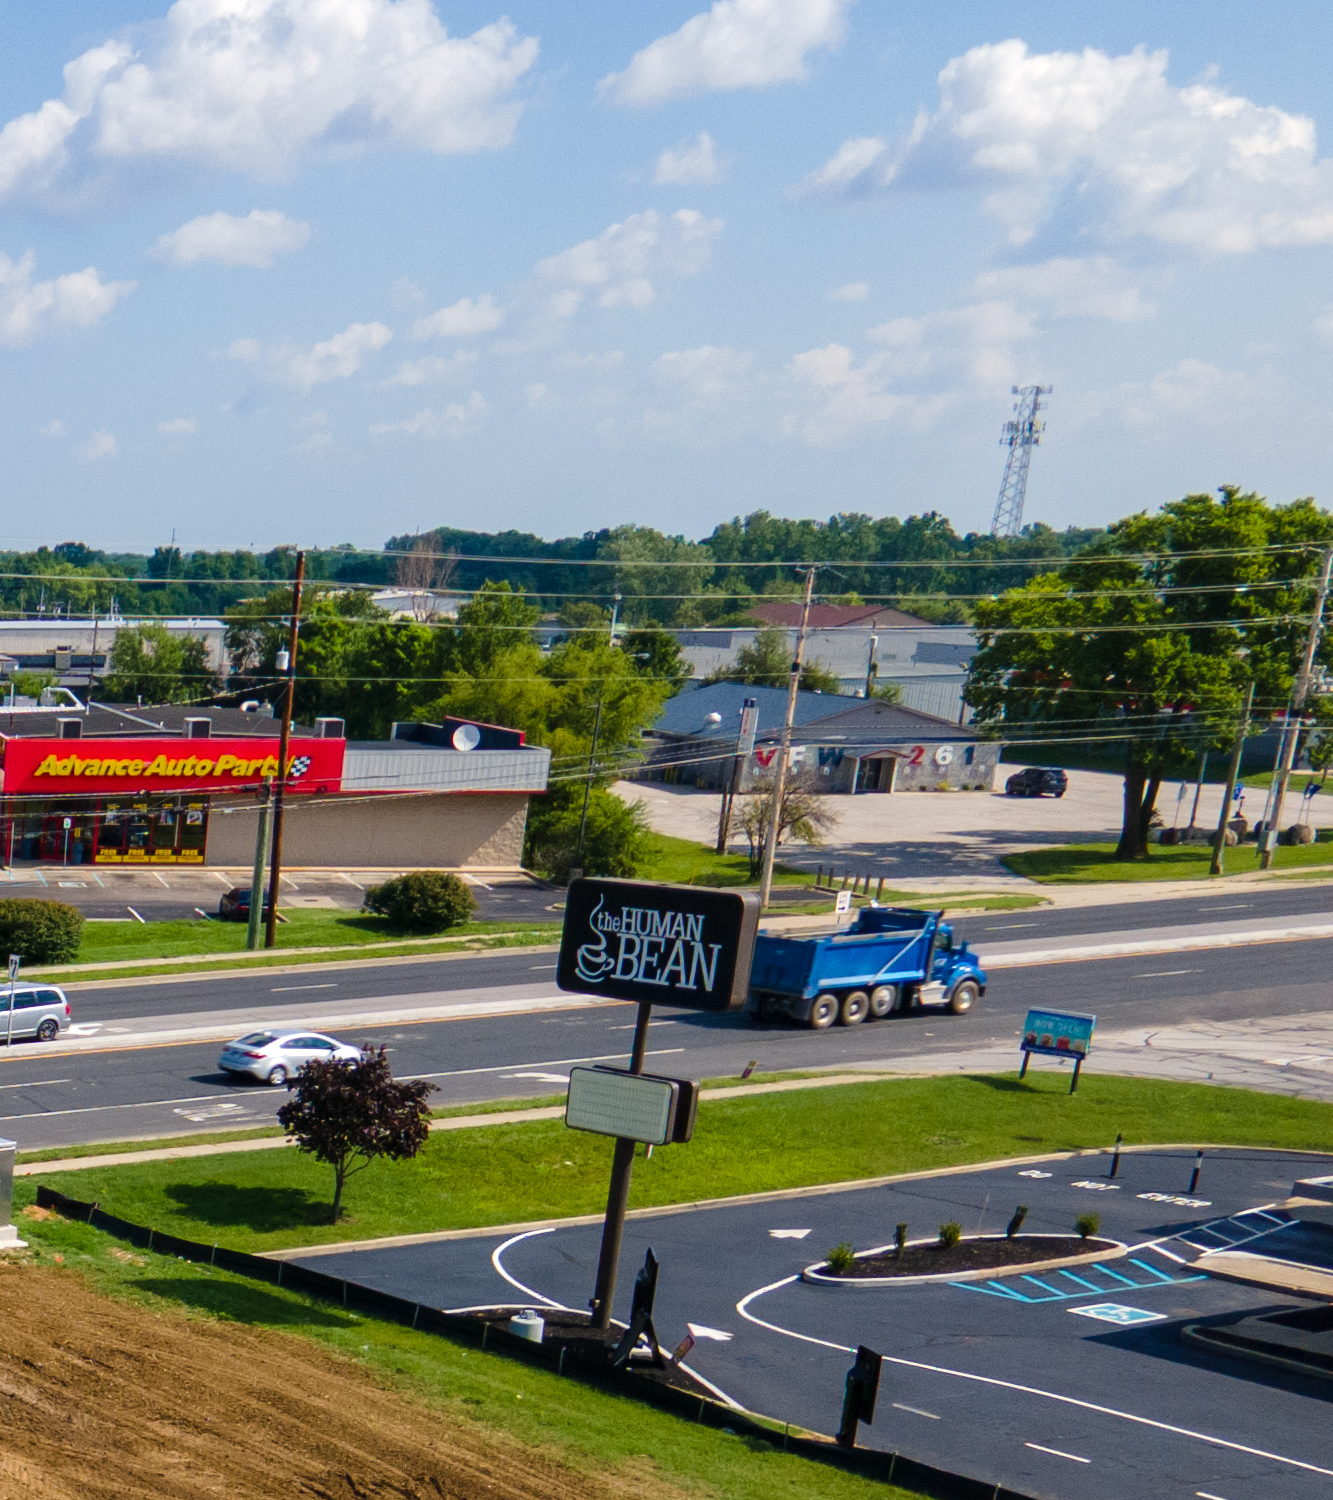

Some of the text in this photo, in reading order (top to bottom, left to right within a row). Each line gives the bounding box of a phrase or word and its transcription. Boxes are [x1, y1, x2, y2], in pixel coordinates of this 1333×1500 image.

[34, 754, 144, 777] Advance
[143, 754, 213, 777] Auto
[909, 745, 975, 766] 261
[597, 906, 705, 942] the HUMAN
[610, 933, 722, 991] BEAN
[1017, 1170, 1212, 1207] DO NOT ENTER
